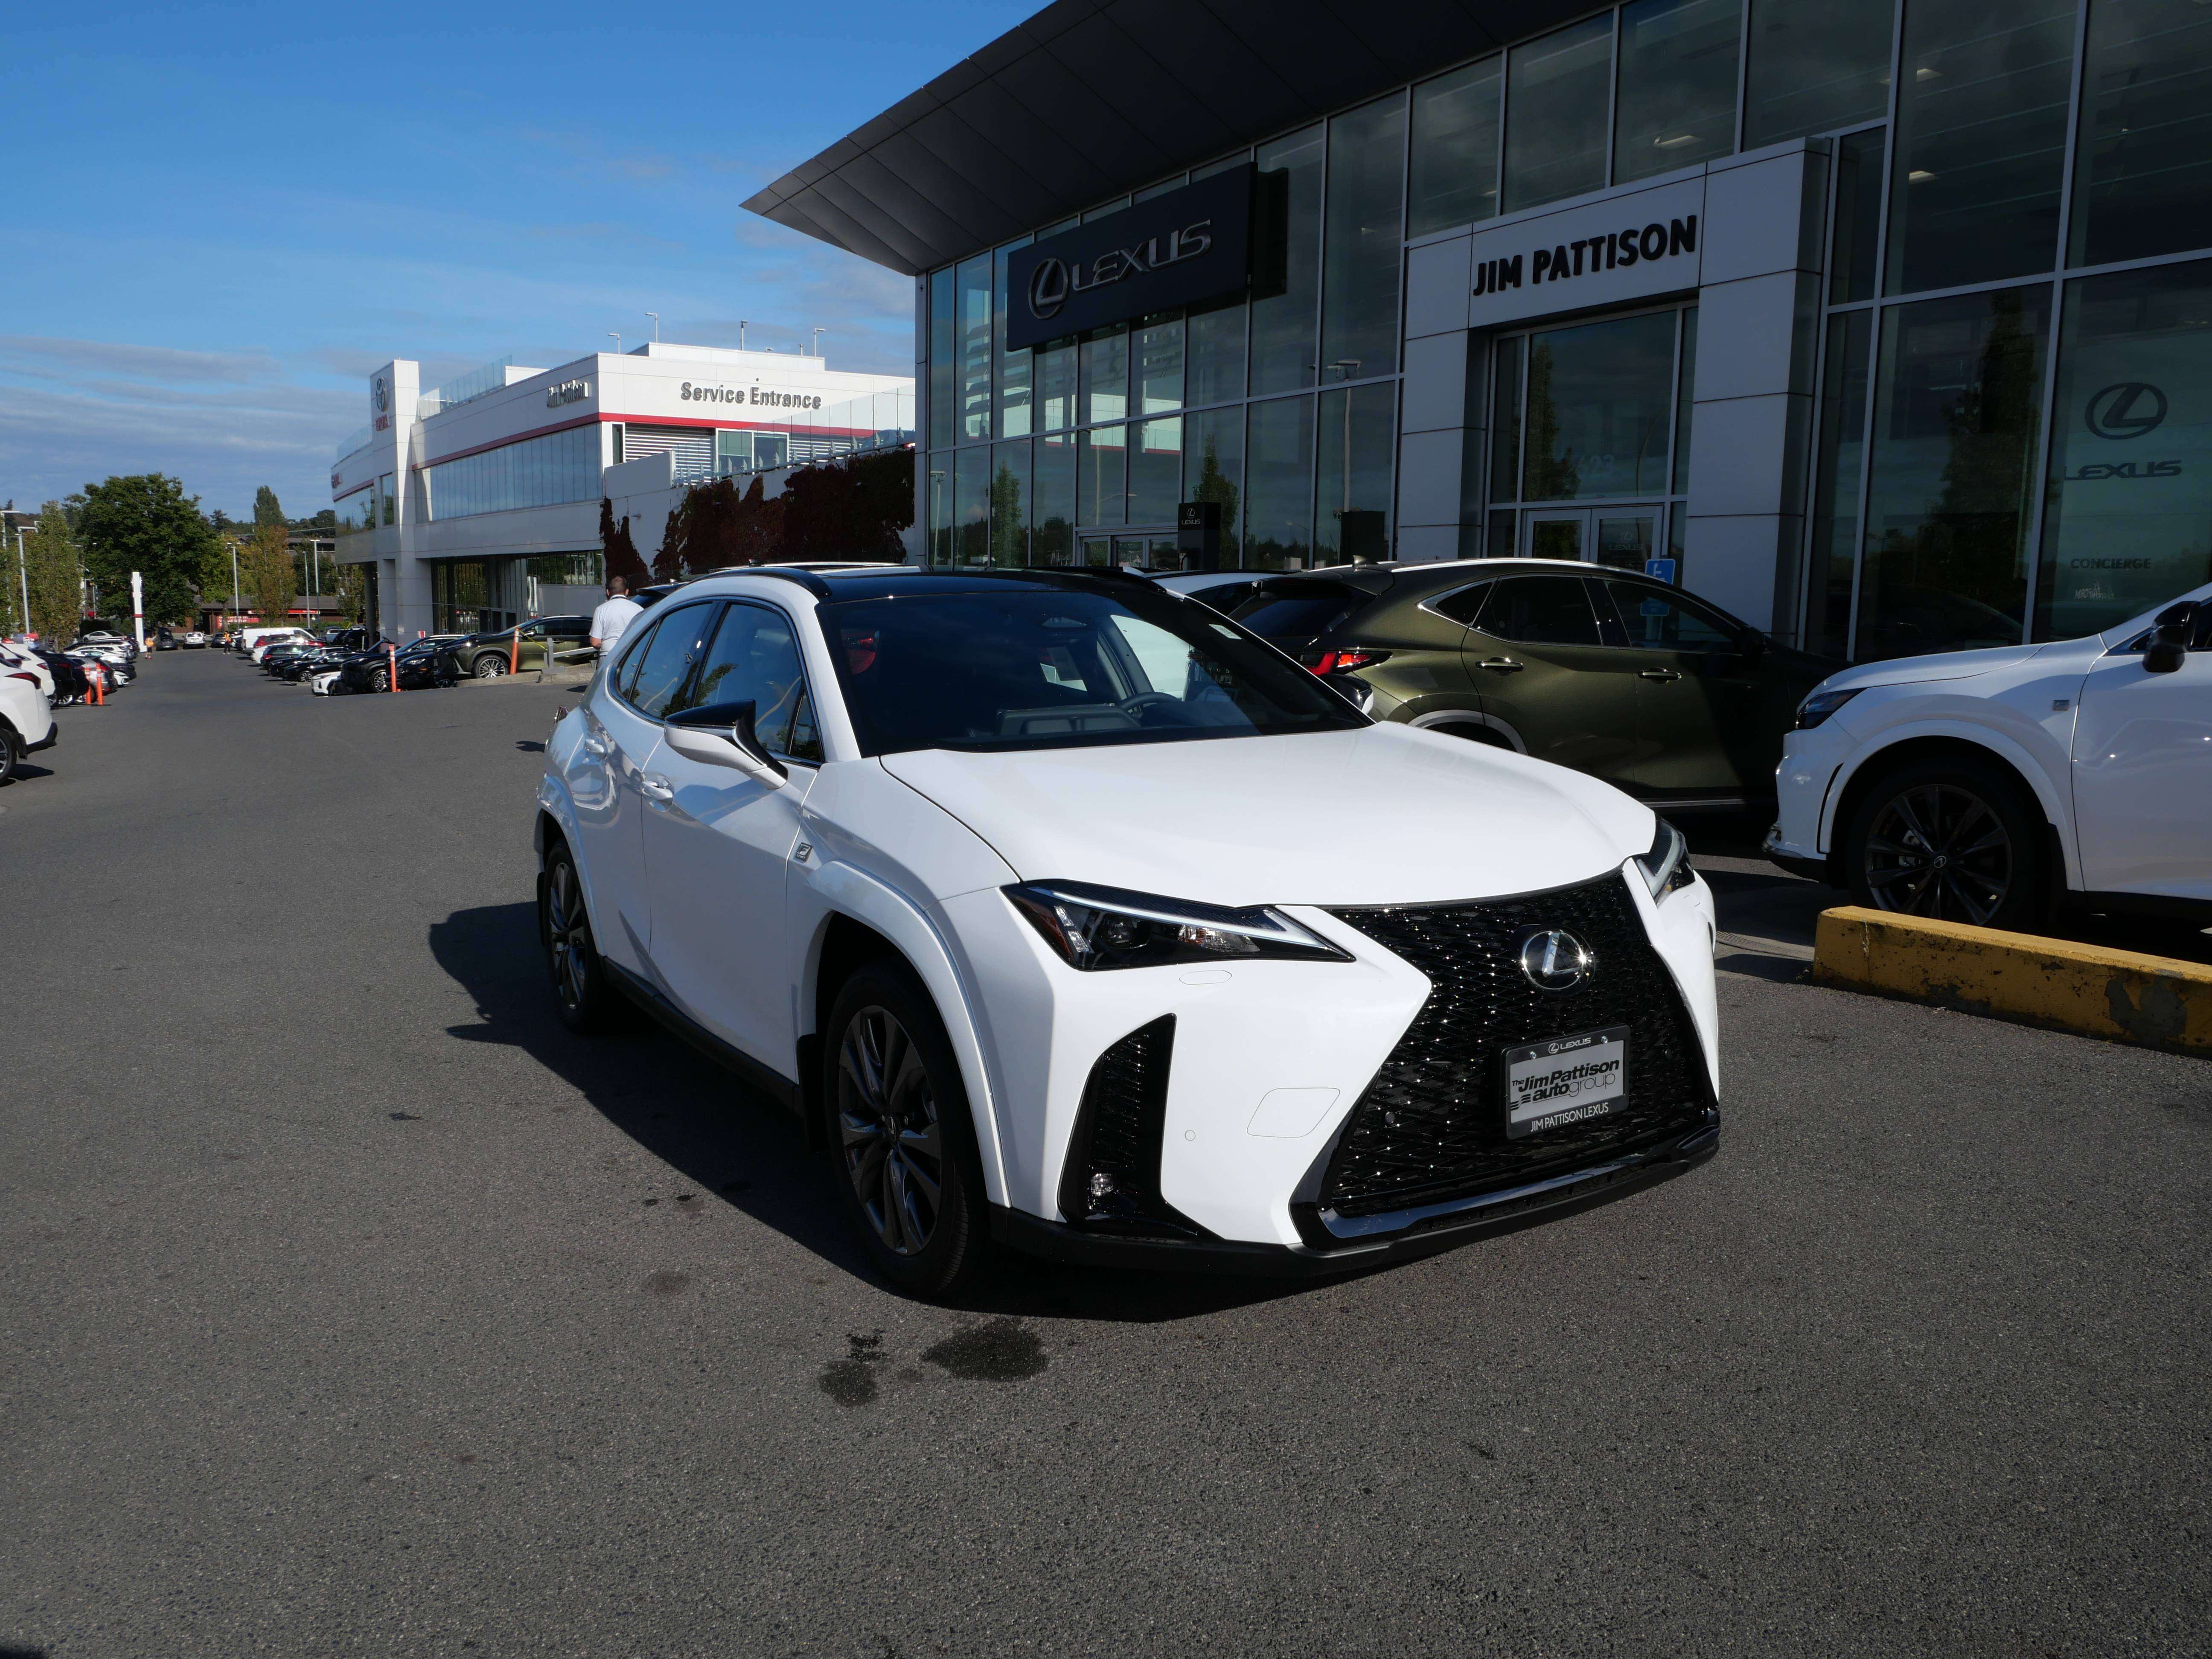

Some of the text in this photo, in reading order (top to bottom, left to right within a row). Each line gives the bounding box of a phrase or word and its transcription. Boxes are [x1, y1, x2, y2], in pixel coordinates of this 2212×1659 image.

[1072, 218, 1211, 291] LEXUS
[1473, 215, 1697, 296] JIM PATTISON
[681, 382, 821, 410] Service Entrance
[2064, 460, 2182, 481] LEXUS
[2071, 558, 2151, 569] CONCIERGE
[1560, 1037, 1591, 1050] LEXUS
[1519, 1076, 1548, 1092] Jim
[1549, 1059, 1620, 1085] Pattison
[1531, 1102, 1609, 1132] JIM PATTISON LEXUS
